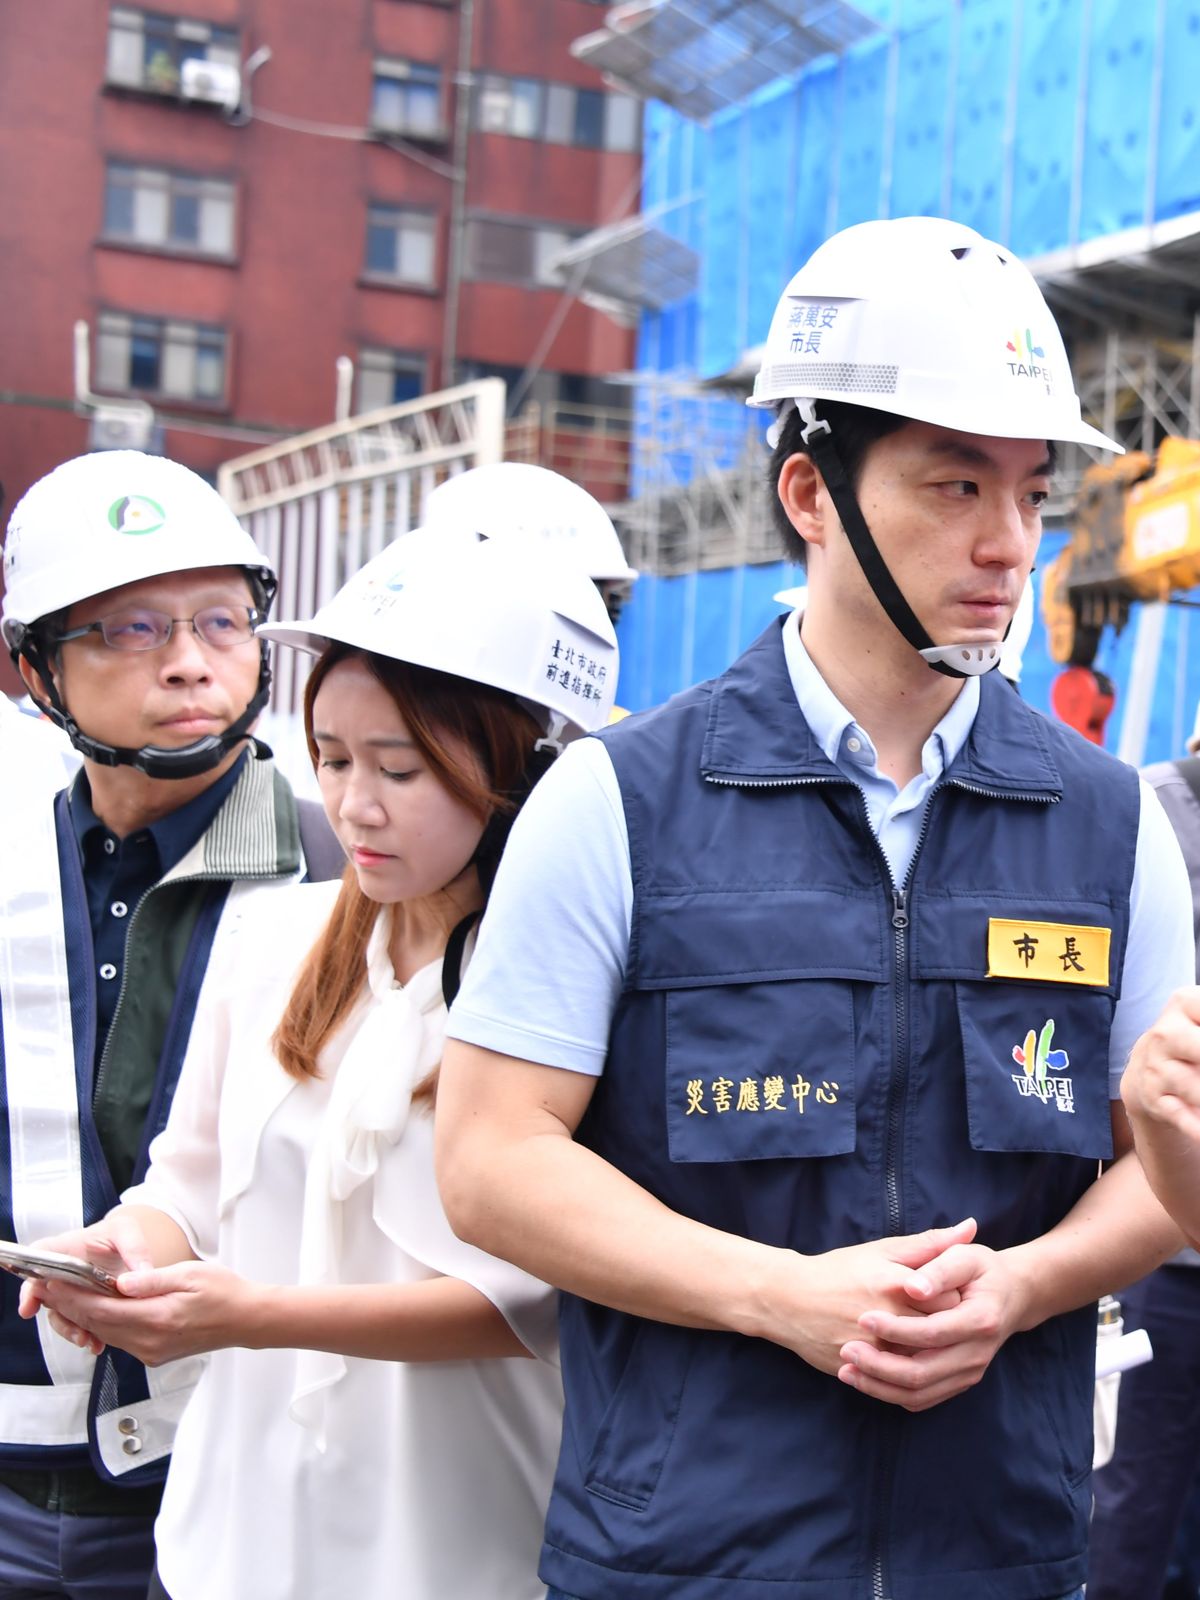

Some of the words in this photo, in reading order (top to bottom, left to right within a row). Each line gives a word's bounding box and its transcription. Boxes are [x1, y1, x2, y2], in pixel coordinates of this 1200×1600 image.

[790, 332, 823, 354] 市長
[1012, 932, 1086, 972] 市長
[685, 1074, 840, 1115] 災害應變中心
[1011, 1074, 1074, 1100] TAIPEI
